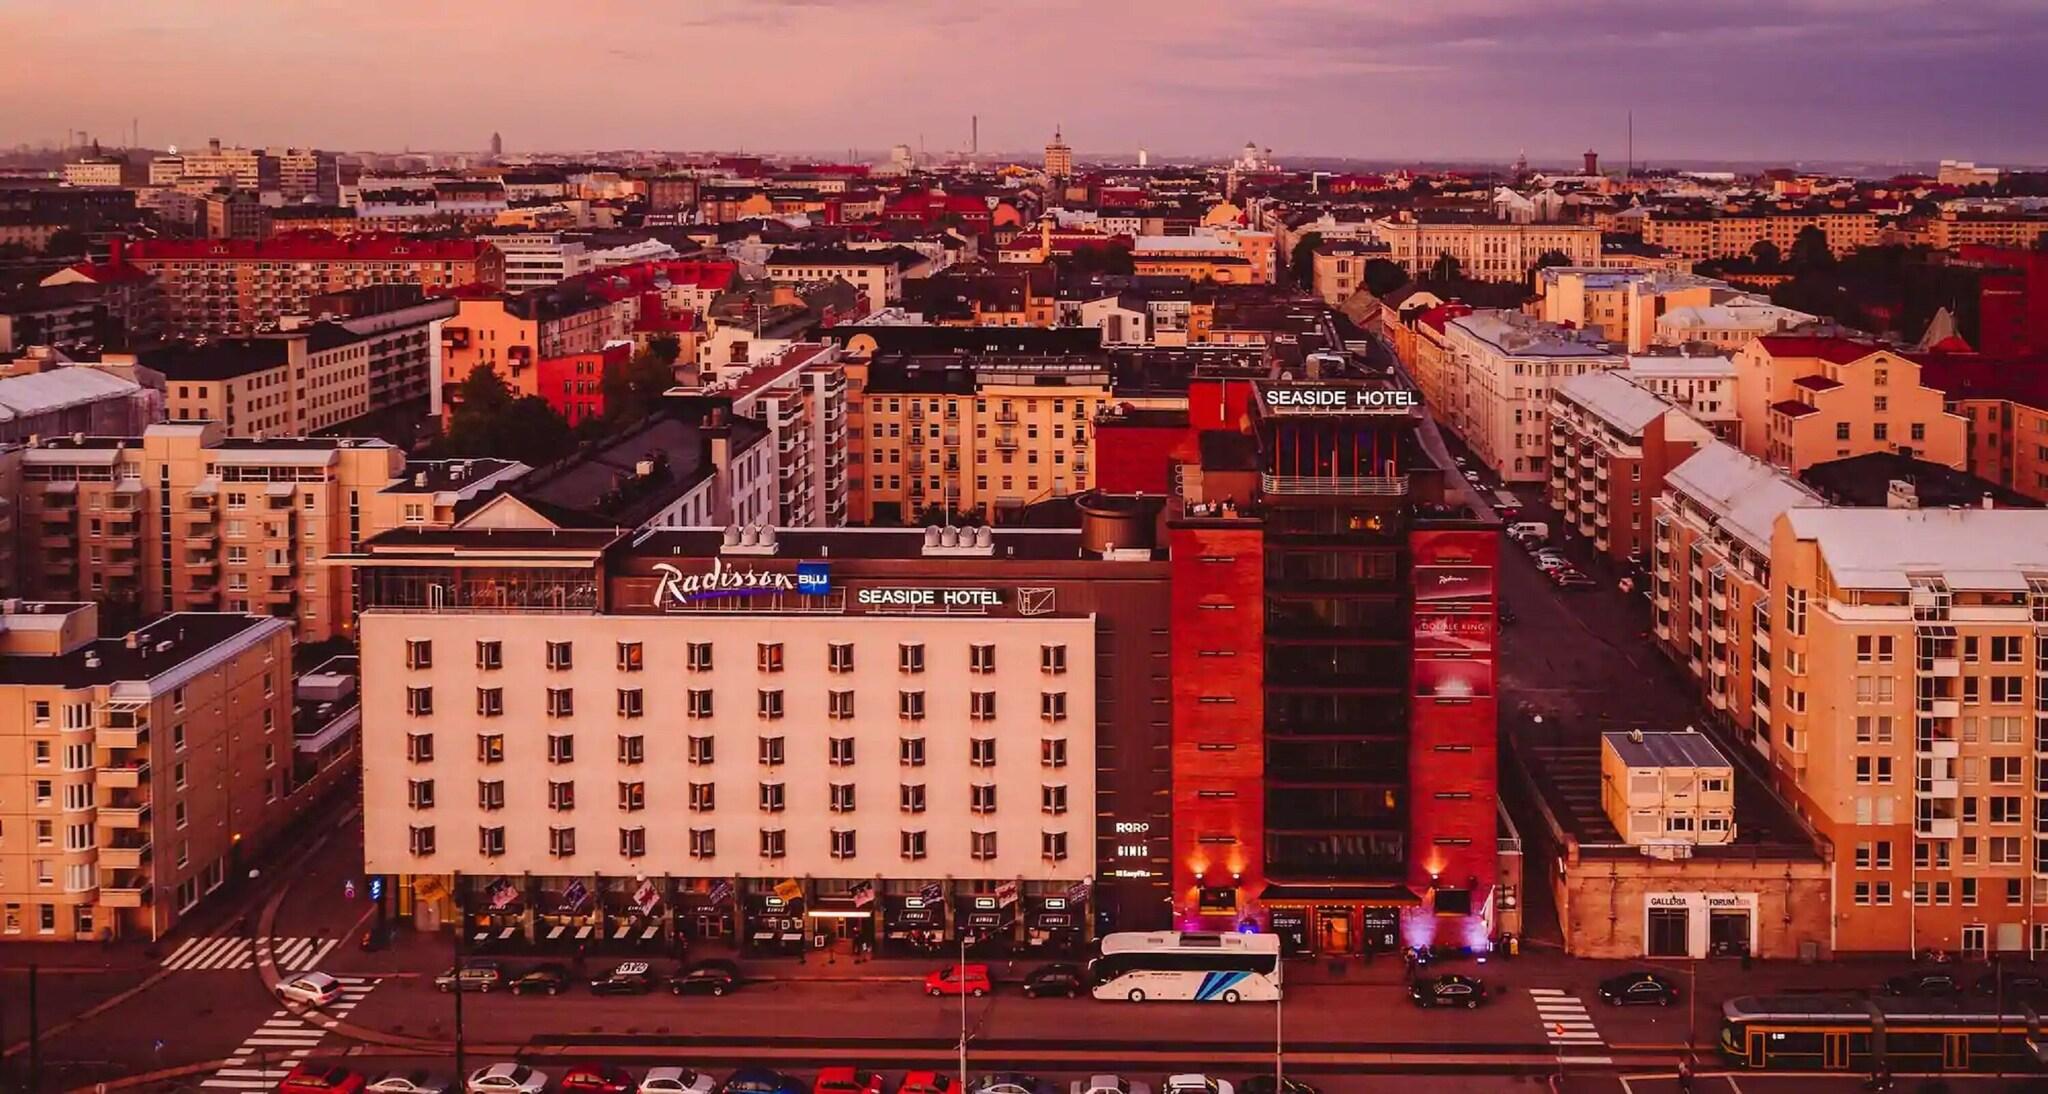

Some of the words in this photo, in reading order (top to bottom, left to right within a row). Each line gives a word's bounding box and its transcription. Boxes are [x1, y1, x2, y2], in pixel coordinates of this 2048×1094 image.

[1266, 391, 1346, 405] SEASIDE
[1357, 391, 1418, 405] HOTEL
[652, 557, 794, 608] Radisson
[858, 590, 934, 604] SEASIDE
[944, 590, 1002, 605] HOTEL
[1709, 898, 1735, 906] FORUM
